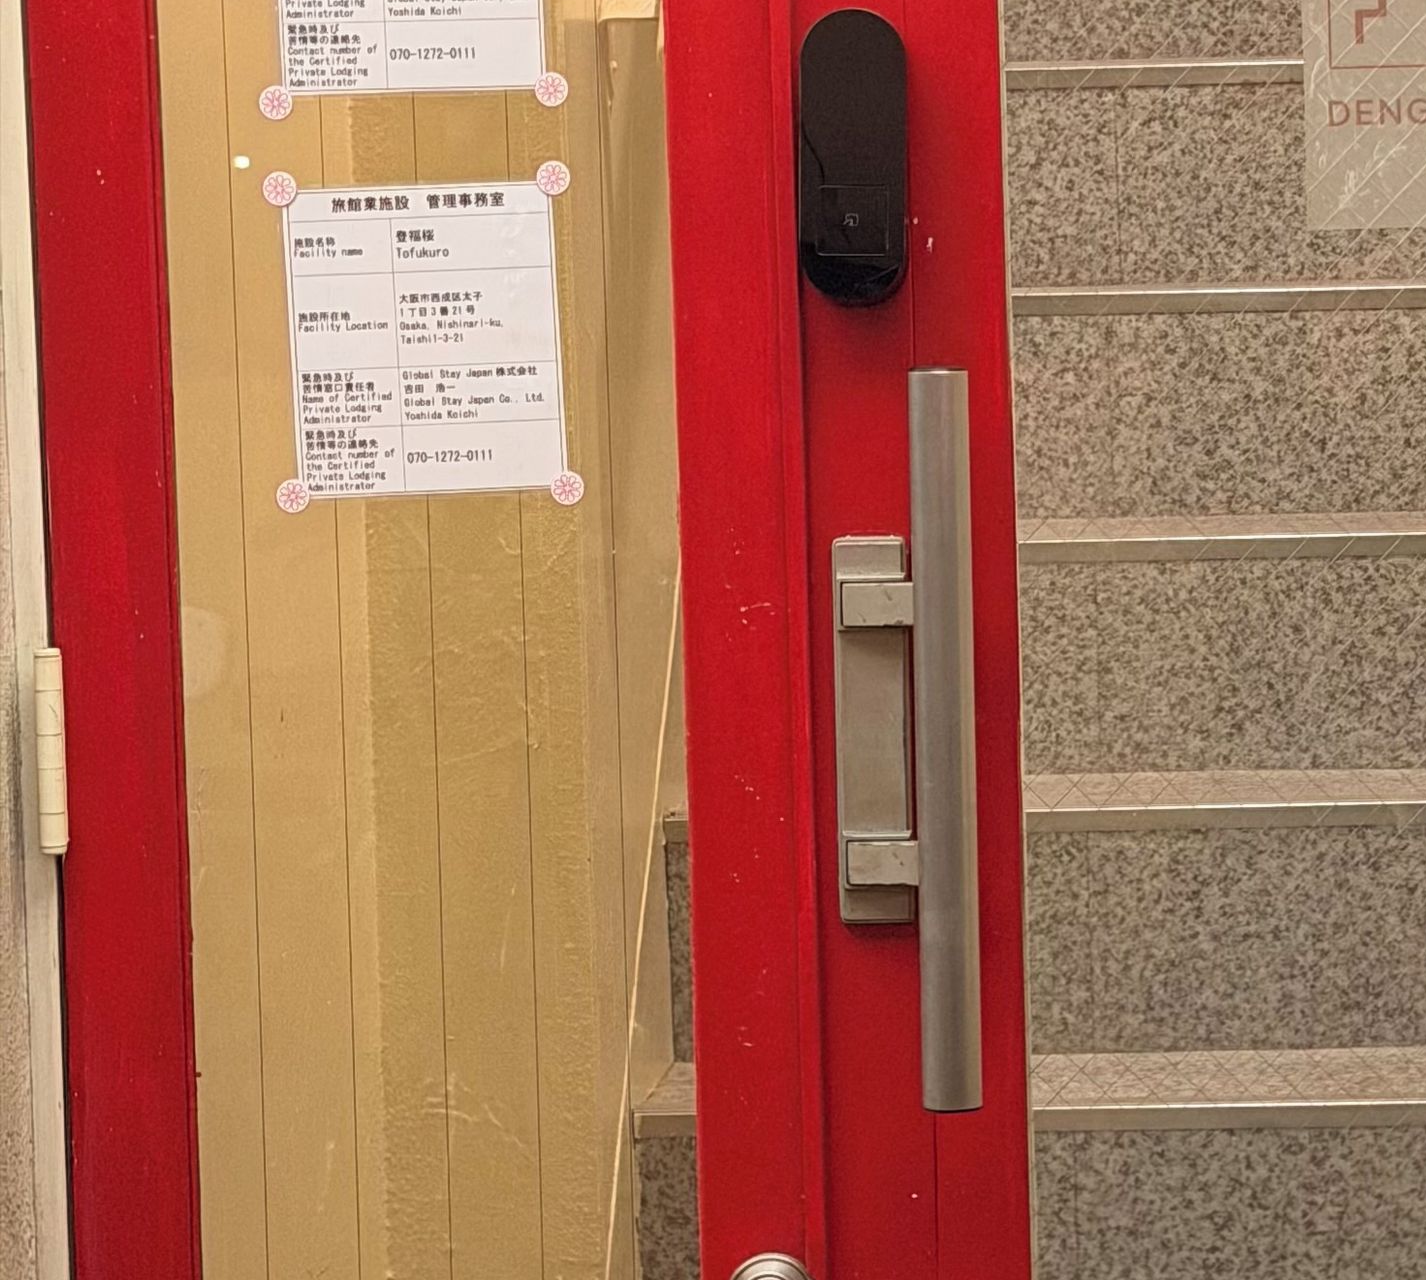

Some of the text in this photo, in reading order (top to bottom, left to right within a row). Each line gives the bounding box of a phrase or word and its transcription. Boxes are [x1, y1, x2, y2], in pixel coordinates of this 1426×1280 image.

[285, 0, 323, 8] Private
[286, 9, 354, 18] Administrator
[388, 6, 462, 17] Yoshida Koichi
[287, 43, 377, 56] Contact number of
[389, 46, 476, 60] 070-1272-0111
[288, 56, 358, 66] the Certified
[288, 67, 369, 77] Private Lodging
[289, 78, 357, 87] Administrator
[331, 191, 505, 213] 旅館業施設 管理事務室
[294, 248, 337, 258] Facility
[396, 246, 450, 259] Tofukuro
[399, 290, 483, 305] 大阪市西成区太子
[298, 320, 389, 332] Facility Location
[402, 365, 538, 380] Global Stay Japan 株式会社
[302, 391, 393, 404] Name of Certified
[403, 397, 435, 408] Global
[441, 396, 463, 407] Stay
[467, 395, 495, 405] Japan
[303, 403, 382, 414] Private Lodging
[303, 415, 371, 425] Administrator
[404, 409, 478, 421] Yoshida Koichi
[305, 448, 395, 461] Contact number of
[406, 448, 492, 464] 070-1272-0111
[307, 460, 376, 472] the Certified
[306, 471, 386, 482] Private Lodging
[307, 482, 376, 492] Administrator
